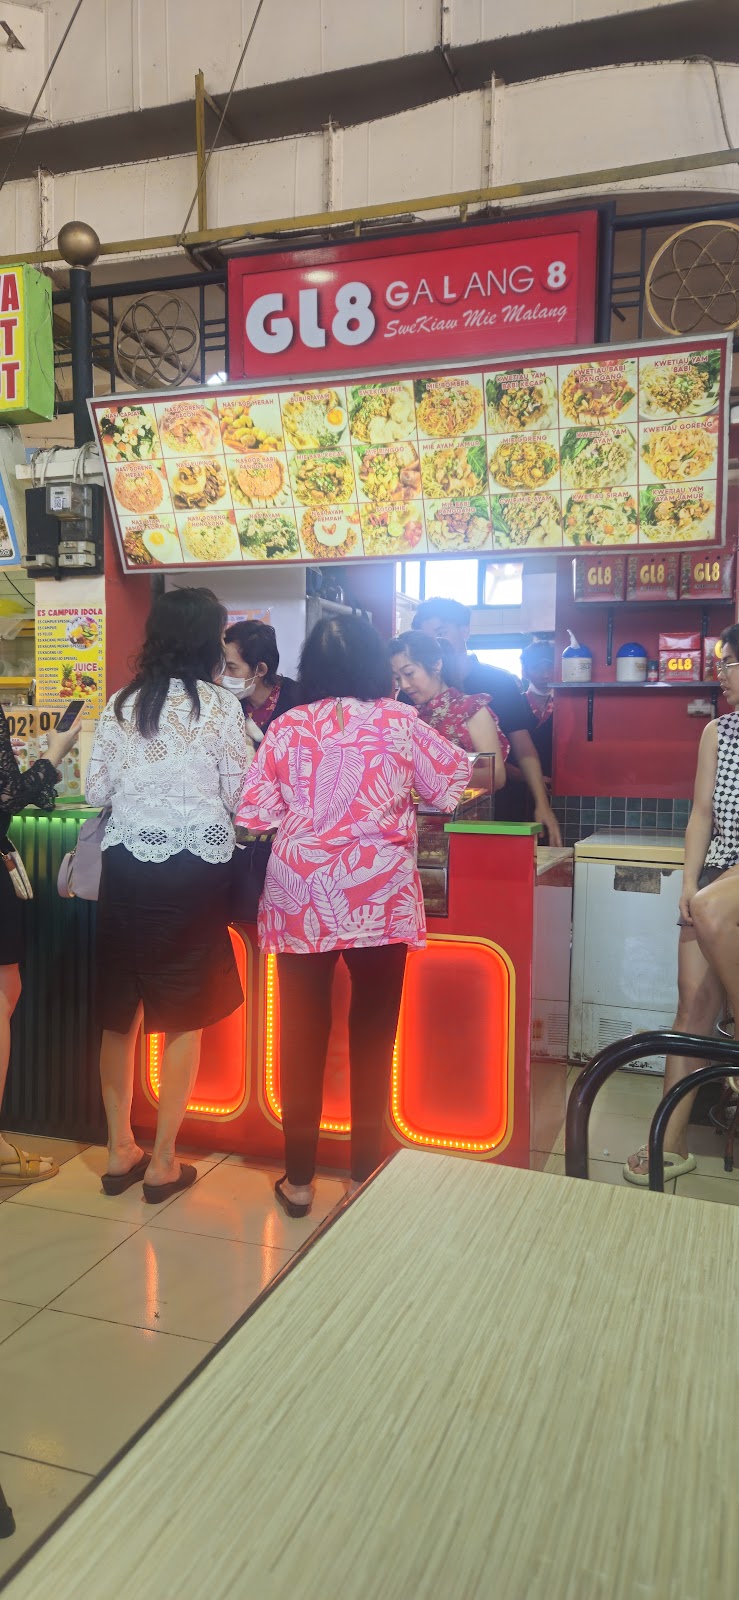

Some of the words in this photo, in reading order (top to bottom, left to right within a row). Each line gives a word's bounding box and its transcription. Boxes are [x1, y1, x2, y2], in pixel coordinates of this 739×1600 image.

[547, 260, 567, 288] 8
[245, 281, 376, 354] GL8
[384, 316, 458, 338] SweKiaw
[463, 308, 496, 328] Mie
[501, 303, 568, 324] Malang
[654, 358, 689, 367] KWETIAU
[574, 366, 606, 375] KWETIAU
[608, 364, 626, 372] BABI
[497, 374, 528, 382] KWETIAU
[579, 373, 622, 383] PANGGANG
[502, 382, 518, 390] BABI
[520, 380, 543, 388] KECAP
[643, 426, 677, 434] KWETIAU
[679, 422, 713, 430] GORENG
[517, 434, 547, 443] GORENG
[652, 487, 686, 495] KWETIAU
[677, 493, 704, 501] JAMUR
[587, 566, 612, 586] GL8
[640, 564, 665, 584] GL8
[694, 561, 720, 582] GL8
[37, 609, 46, 617] ES
[48, 608, 79, 616] CAMPUR
[81, 608, 103, 616] IDOLA
[73, 662, 98, 672] JUICE
[668, 658, 692, 670] GL8
